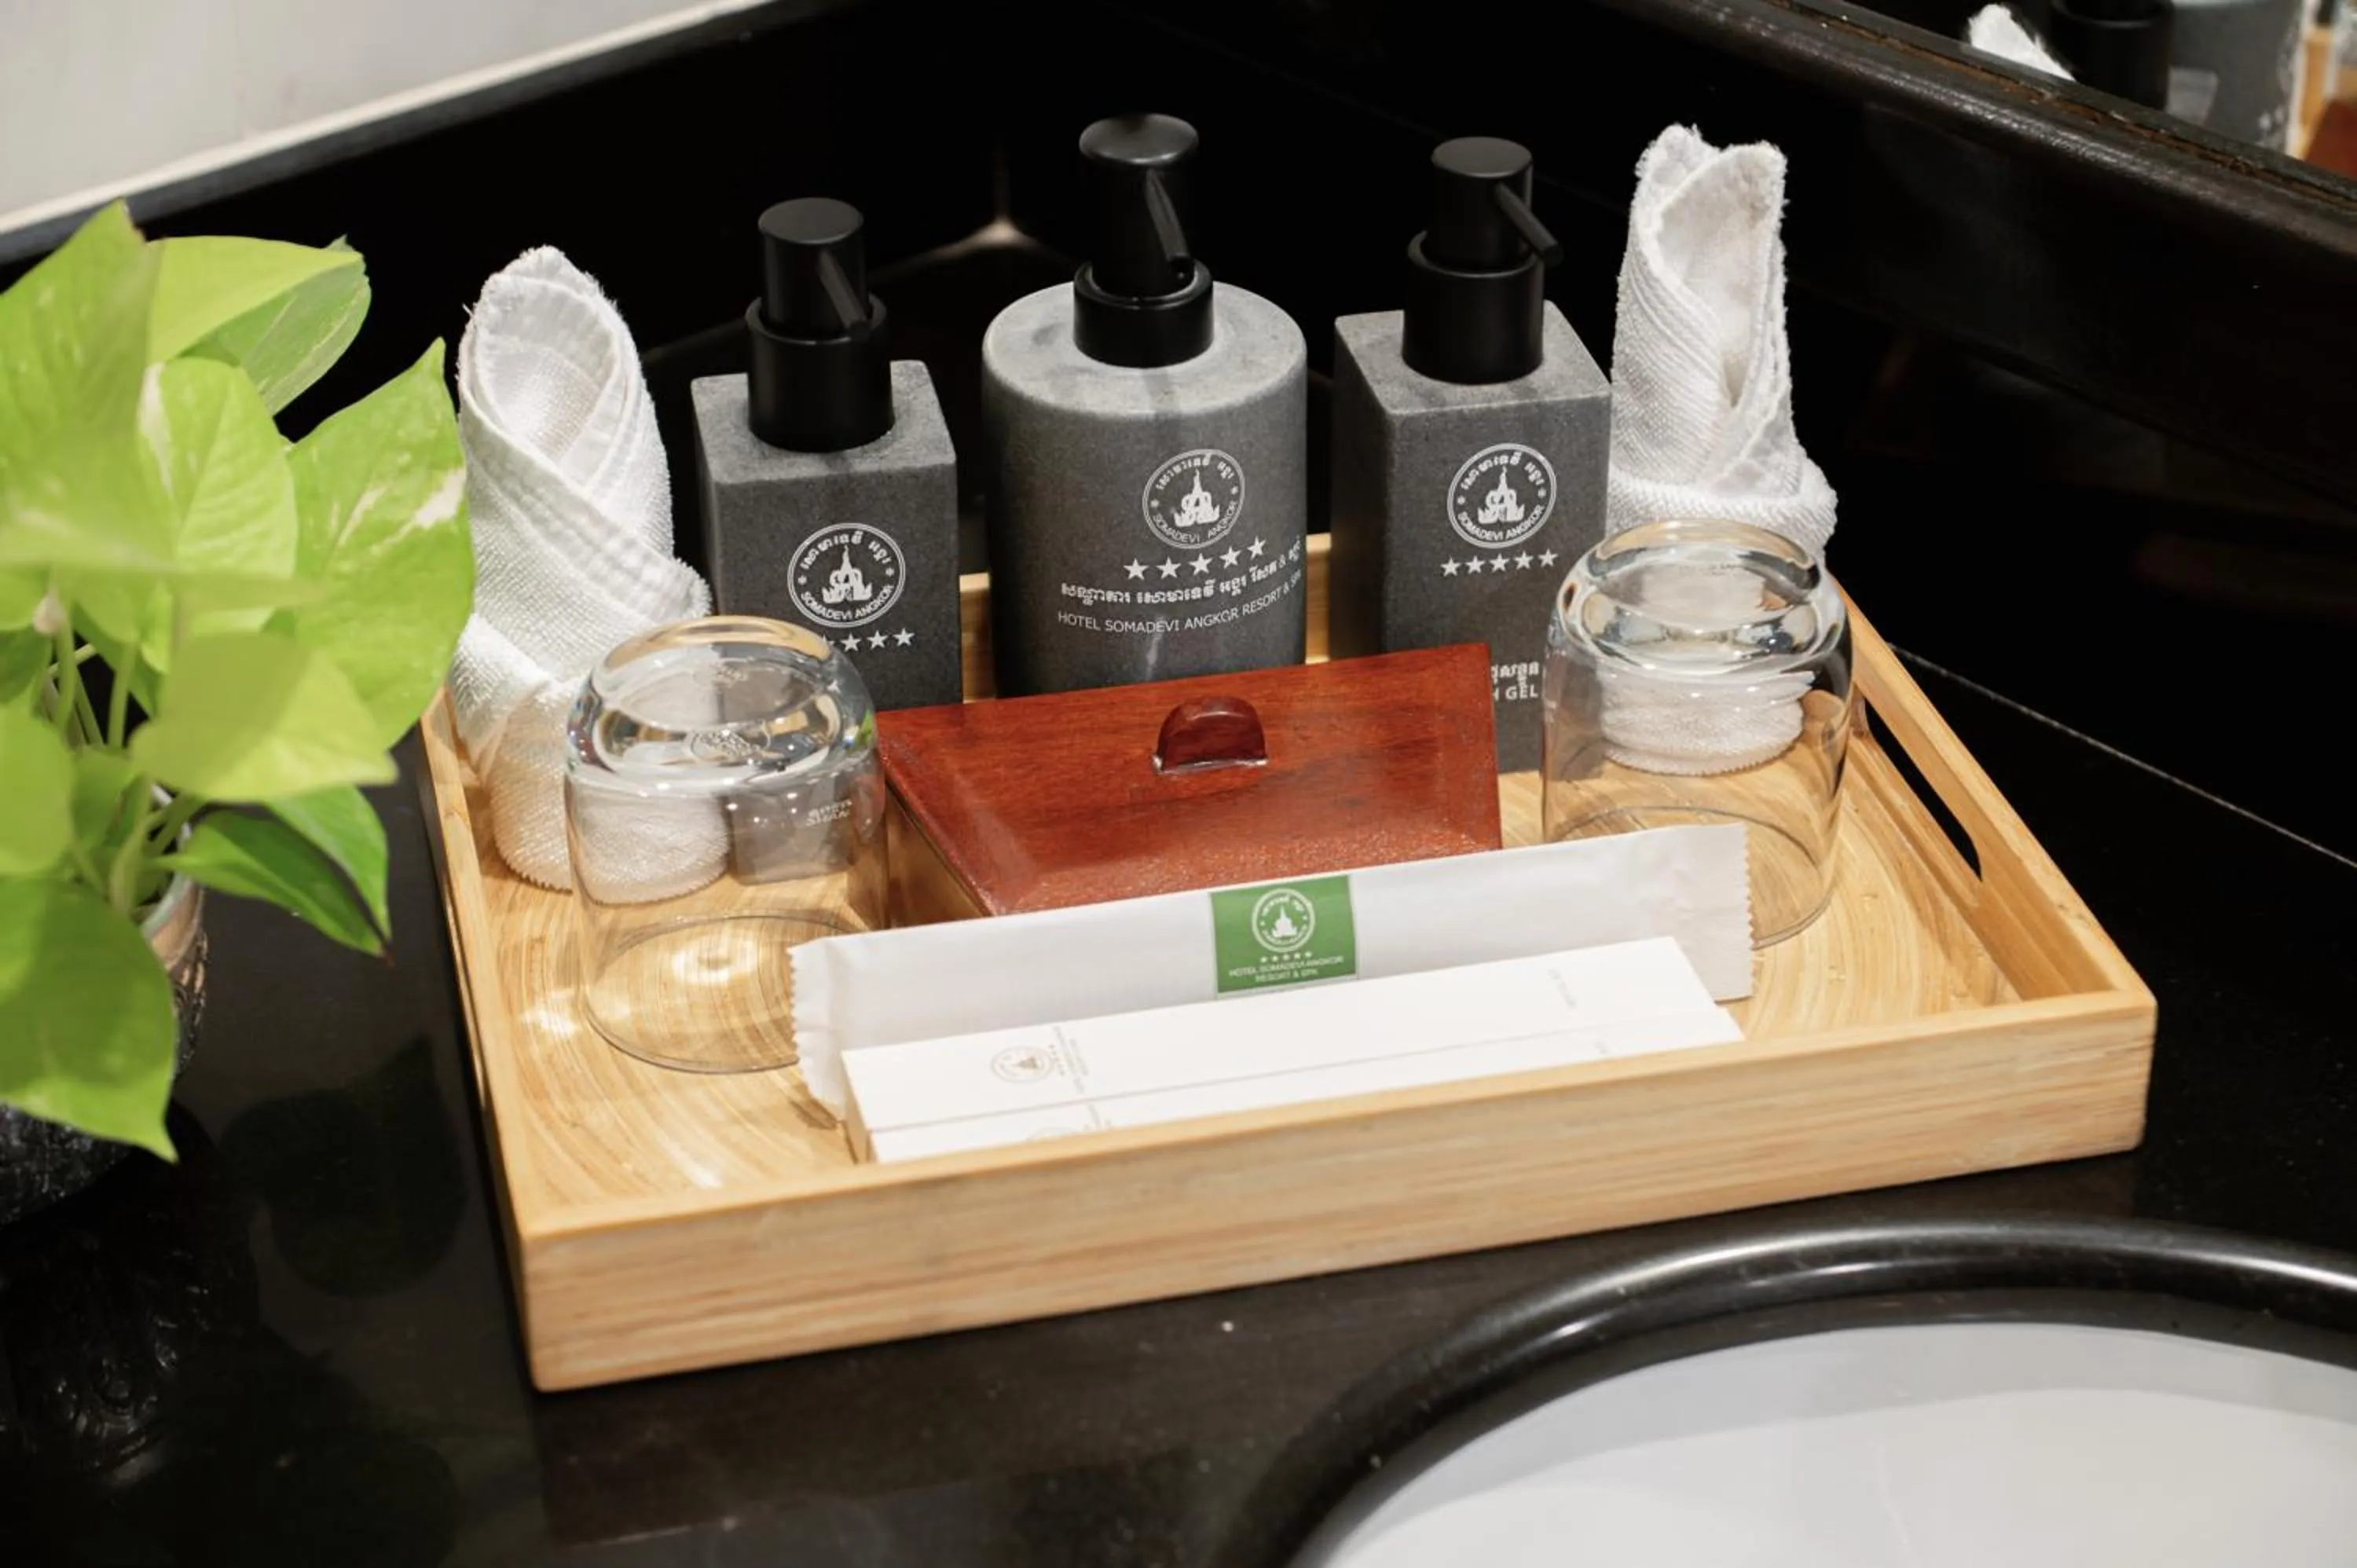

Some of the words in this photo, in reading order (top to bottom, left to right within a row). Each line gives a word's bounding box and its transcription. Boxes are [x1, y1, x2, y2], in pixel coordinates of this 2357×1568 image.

[1152, 513, 1200, 543] SOMADEVI
[1208, 500, 1237, 539] ANGKOR
[1457, 511, 1504, 541] SOMADEVI
[1505, 504, 1545, 540] ANGKOR
[801, 591, 853, 620] SOMADEVI
[855, 584, 895, 619] ANGKOR
[1058, 609, 1102, 631] HOTEL
[1104, 619, 1180, 634] SOMADEVI
[1184, 607, 1240, 629] ANGKOR
[1242, 586, 1283, 617] RESORT
[1505, 683, 1539, 701] GEL
